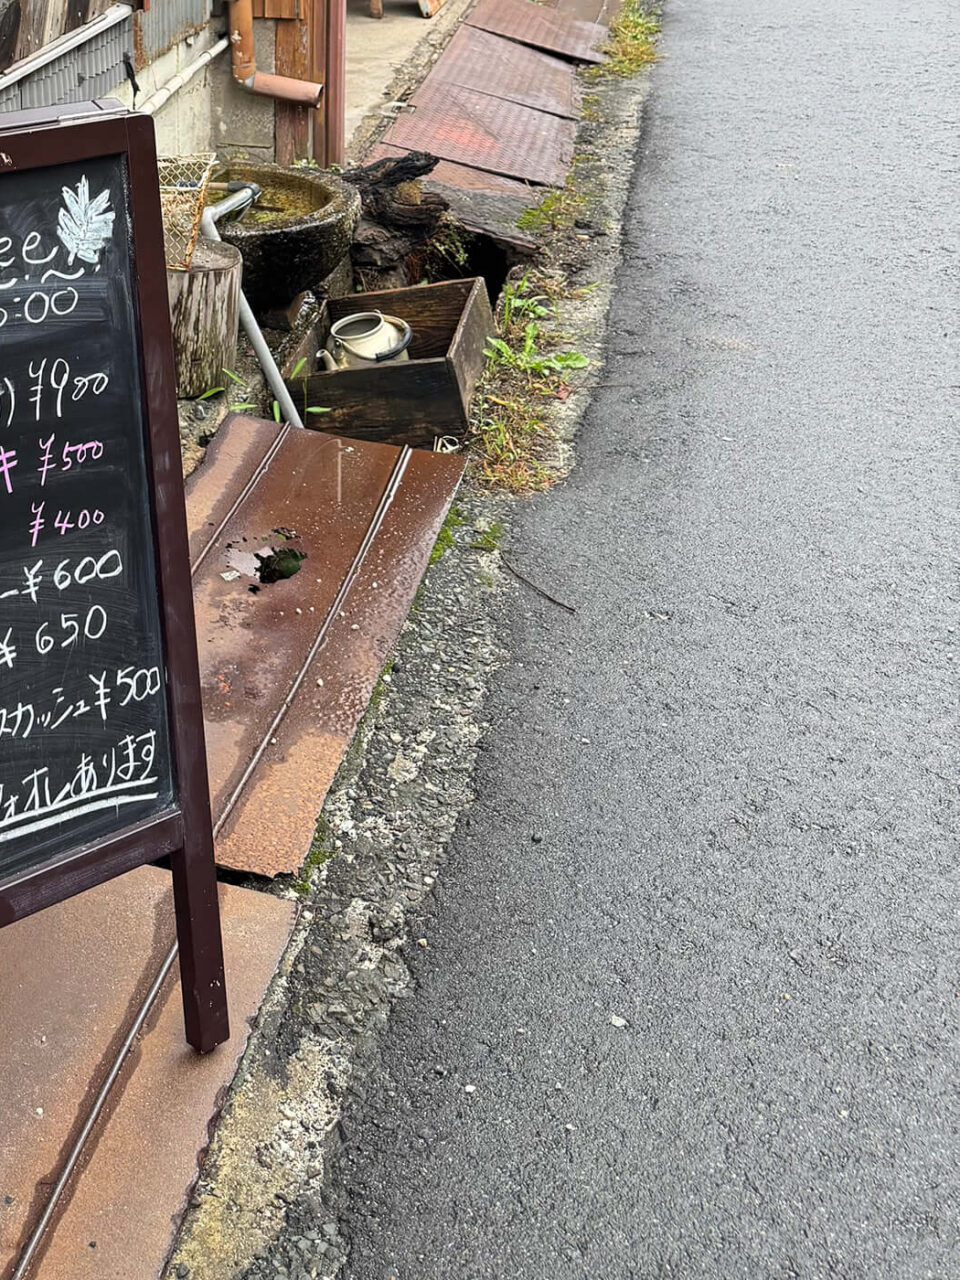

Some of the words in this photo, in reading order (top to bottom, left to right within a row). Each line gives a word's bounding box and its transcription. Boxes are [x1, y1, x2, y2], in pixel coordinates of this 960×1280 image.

[29, 358, 109, 421] ¥900
[37, 433, 104, 486] ¥500
[28, 501, 105, 547] ¥400
[21, 549, 123, 604] ¥600
[89, 666, 161, 721] ¥500
